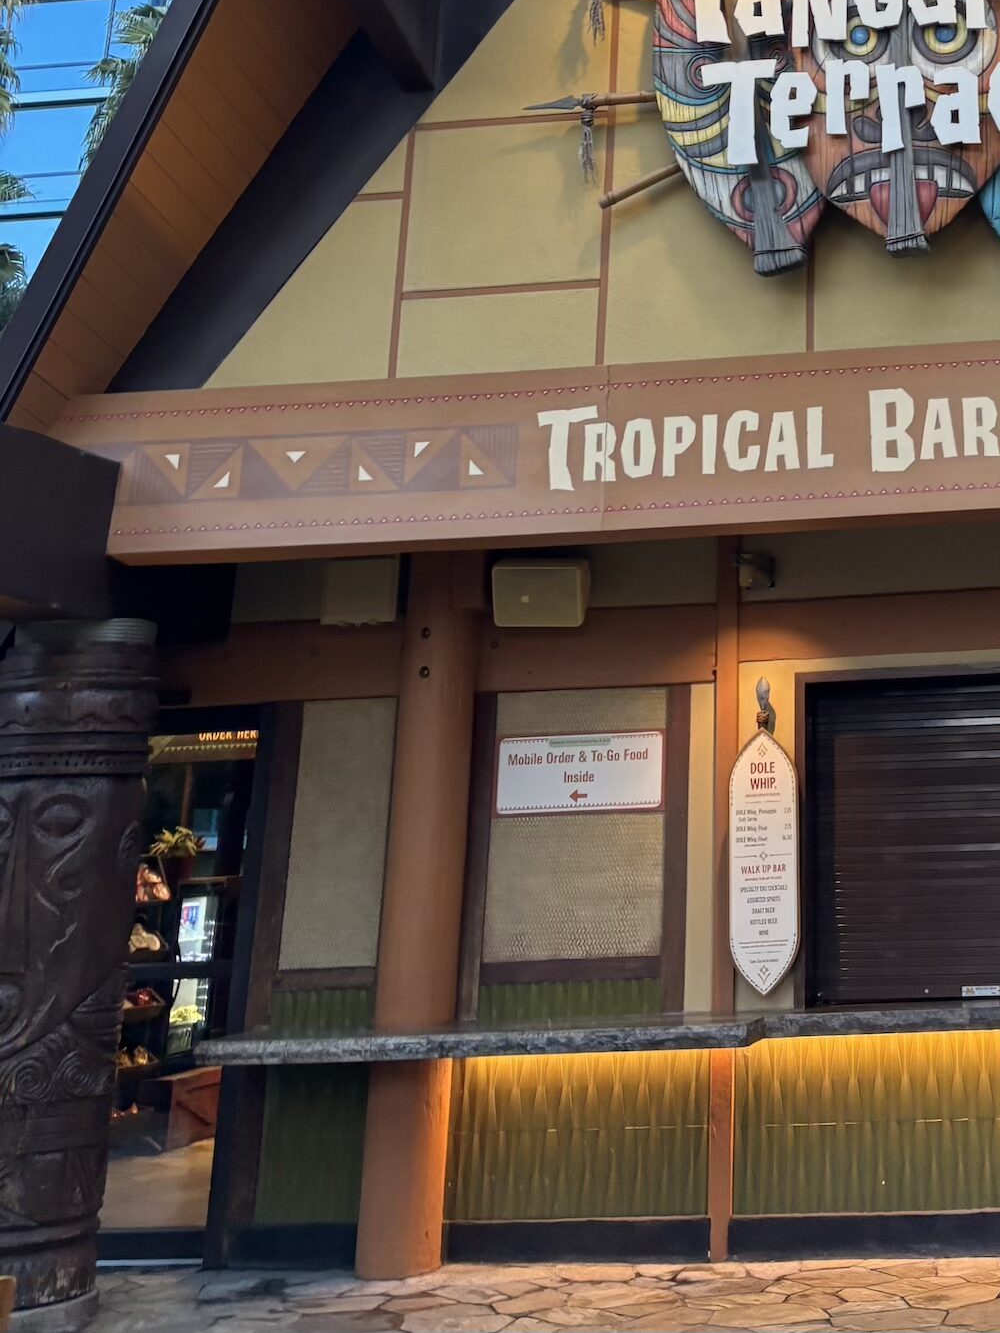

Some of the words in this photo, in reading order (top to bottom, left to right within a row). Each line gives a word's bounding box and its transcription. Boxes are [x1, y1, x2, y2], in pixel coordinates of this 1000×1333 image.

[537, 405, 834, 491] TROPICAL
[868, 387, 1000, 472] BAR
[508, 752, 543, 766] Mobile
[546, 751, 575, 764] Order
[578, 750, 587, 762] &
[591, 749, 620, 762] To-Go
[624, 747, 648, 761] Food
[750, 761, 776, 774] DOLE
[564, 770, 595, 783] Inside
[741, 865, 760, 874] WALK
[762, 864, 771, 874] UP
[772, 863, 786, 872] BAR
